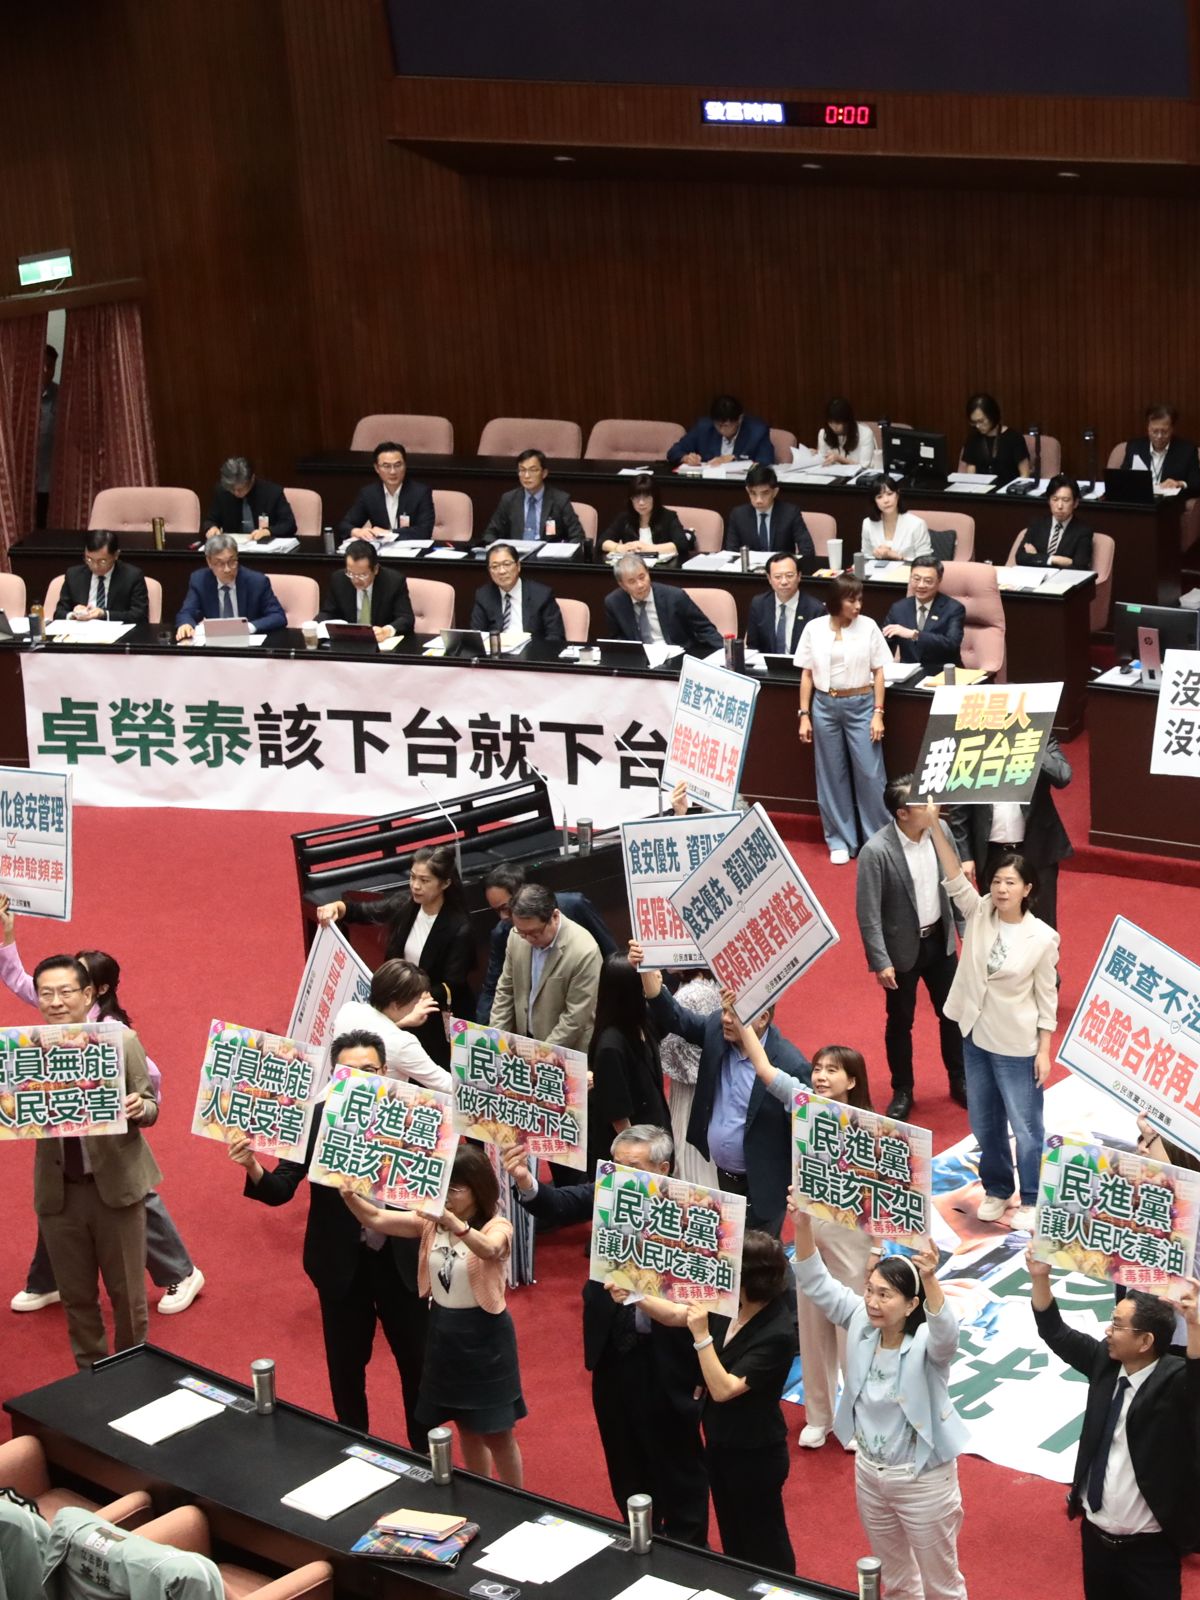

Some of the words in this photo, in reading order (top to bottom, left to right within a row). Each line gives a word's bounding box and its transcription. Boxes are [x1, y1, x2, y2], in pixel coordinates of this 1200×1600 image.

[826, 105, 869, 124] 0:00
[680, 677, 750, 730] 嚴查不法廠商
[954, 689, 1032, 732] 我是人
[37, 697, 668, 793] 卓榮泰該下台就下台
[670, 722, 739, 787] 檢驗合格再上架
[918, 727, 1044, 795] 我反台毒
[628, 836, 681, 876] 食安優先
[686, 832, 726, 871] 資訊
[681, 876, 733, 941] 食安優先
[722, 826, 777, 895] 資訊透明
[636, 897, 691, 941] 保障消
[711, 881, 814, 994] 保障消費者權益
[211, 1042, 313, 1100] 官員無能
[469, 1046, 565, 1106] 民進黨
[201, 1085, 305, 1145] 人民受害
[343, 1088, 442, 1150] 民進黨
[456, 1084, 580, 1145] 做不好就下台
[318, 1127, 445, 1198] 最該下架
[813, 1116, 911, 1182] 民進黨
[613, 1188, 719, 1250] 民進黨
[800, 1155, 926, 1234] 最該下架
[1060, 1164, 1173, 1232] 民進黨
[598, 1228, 734, 1291] 讓人民吃毒油
[1040, 1206, 1185, 1275] 讓人民吃毒油
